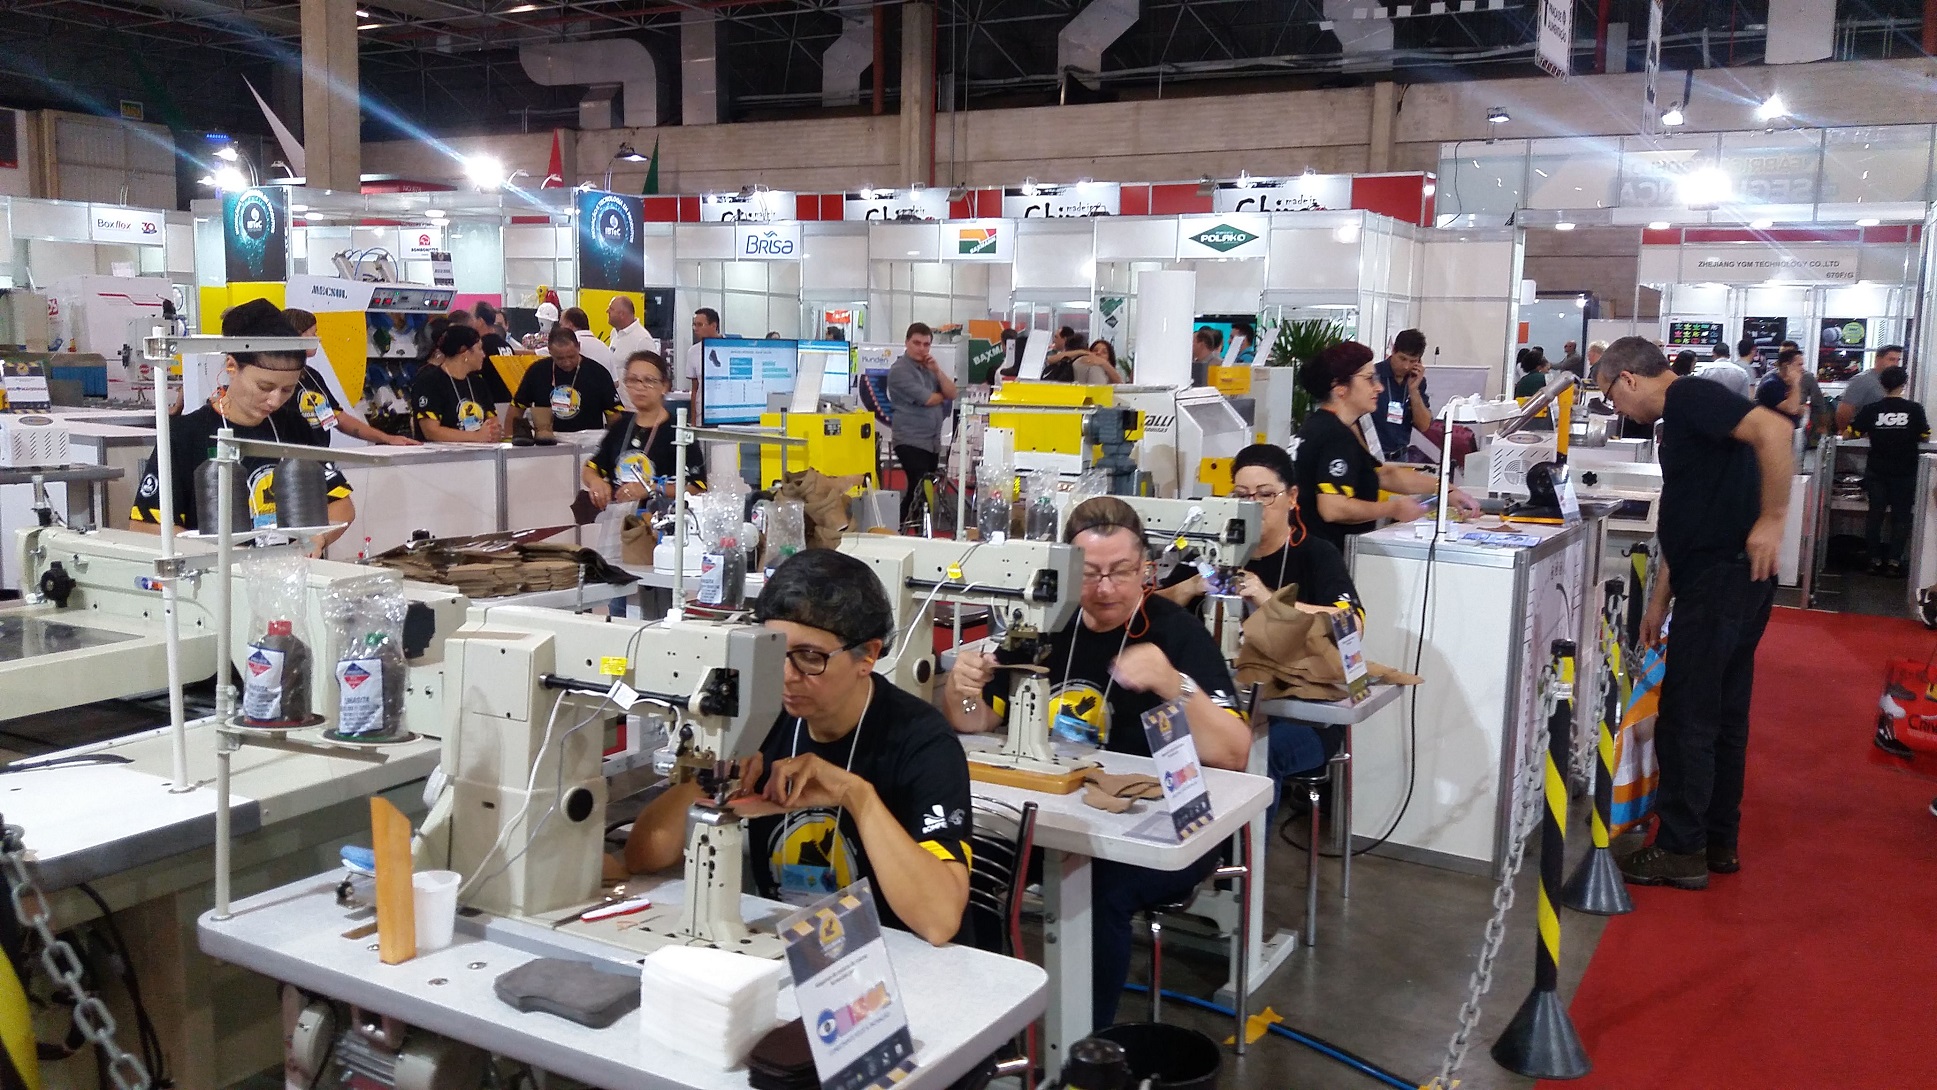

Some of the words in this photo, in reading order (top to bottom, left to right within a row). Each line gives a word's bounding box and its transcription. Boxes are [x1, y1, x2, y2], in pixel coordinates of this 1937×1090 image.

[1200, 233, 1246, 243] POLAKO
[1698, 260, 1735, 268] ZHEJIANG
[1736, 260, 1753, 268] YGM
[1754, 260, 1808, 268] TECHNOLOGY
[972, 344, 1002, 366] BAXM
[1875, 412, 1910, 427] JGB
